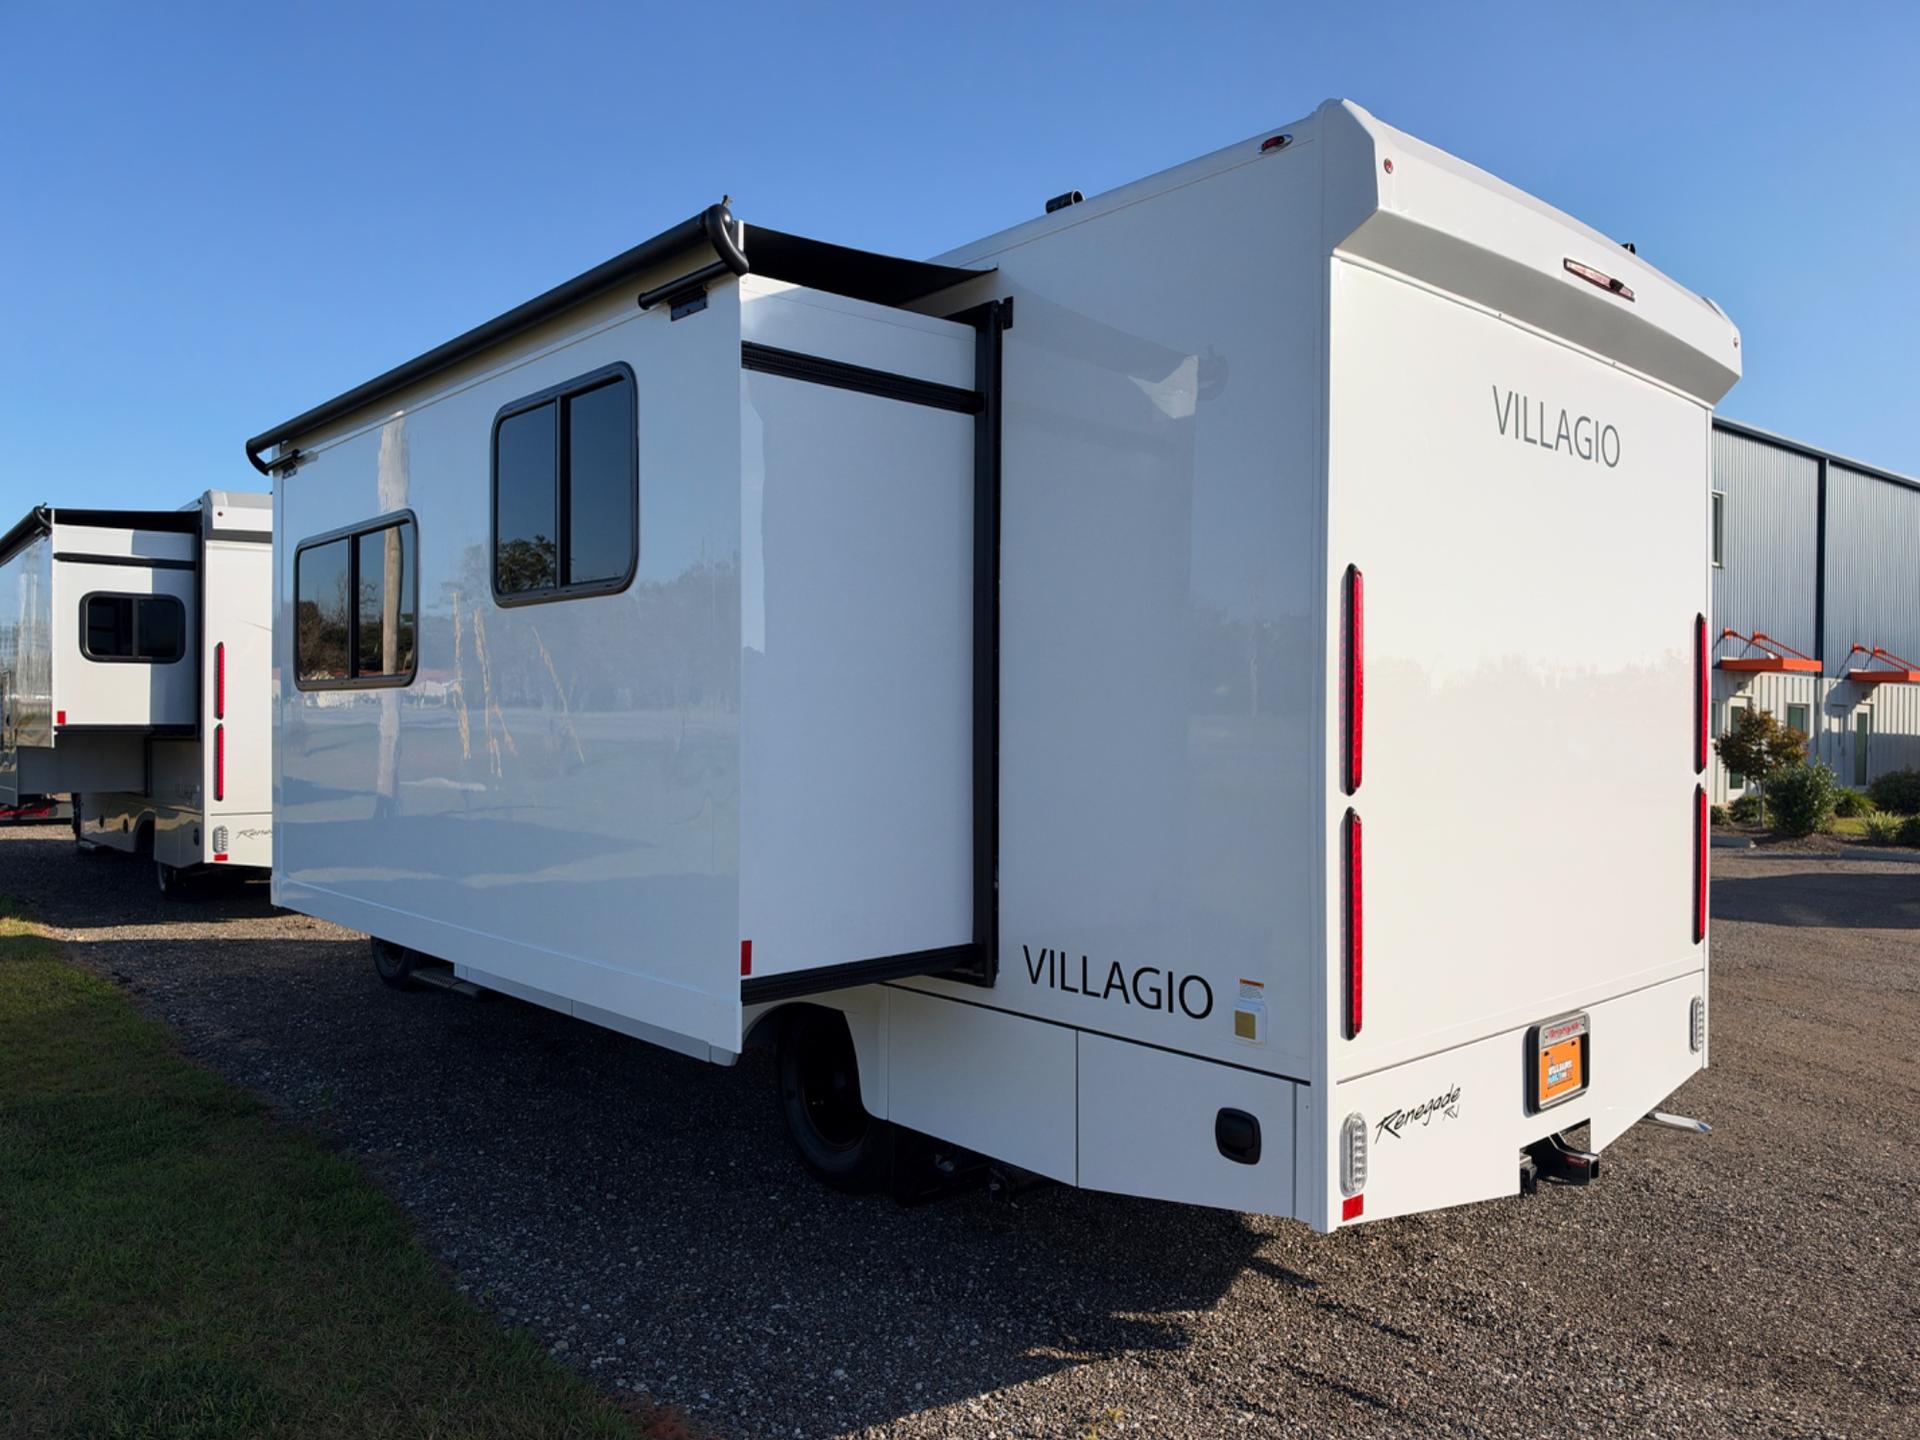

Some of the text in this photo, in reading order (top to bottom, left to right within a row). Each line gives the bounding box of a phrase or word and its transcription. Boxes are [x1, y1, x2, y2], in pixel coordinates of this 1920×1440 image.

[1492, 384, 1620, 468] VILLAGIO
[1022, 944, 1214, 1020] VILLAGIO
[1375, 1083, 1461, 1144] Renegade
[1443, 1105, 1460, 1122] RV
